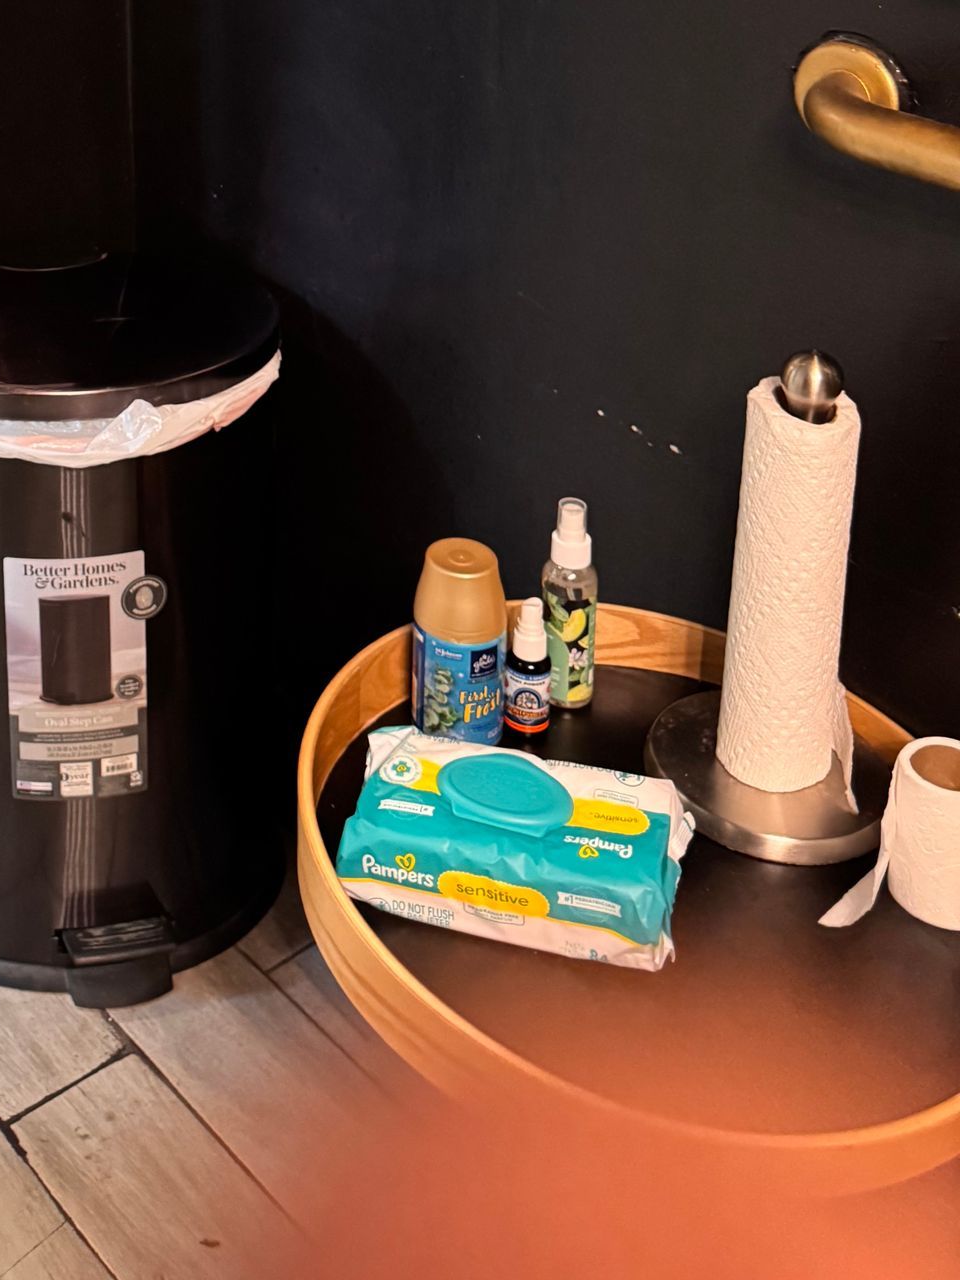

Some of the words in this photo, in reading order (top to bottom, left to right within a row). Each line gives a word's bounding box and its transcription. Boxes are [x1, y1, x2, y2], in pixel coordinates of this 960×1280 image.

[23, 563, 71, 577] Better
[73, 561, 127, 576] Homes
[459, 685, 488, 705] First
[464, 688, 501, 724] Frost
[593, 812, 639, 824] sensitive
[563, 835, 633, 859] Pampers
[361, 854, 434, 887] Pampers
[456, 882, 529, 907] sensitive
[392, 900, 406, 911] DO
[407, 902, 425, 915] NOT
[428, 906, 455, 920] FLUSH
